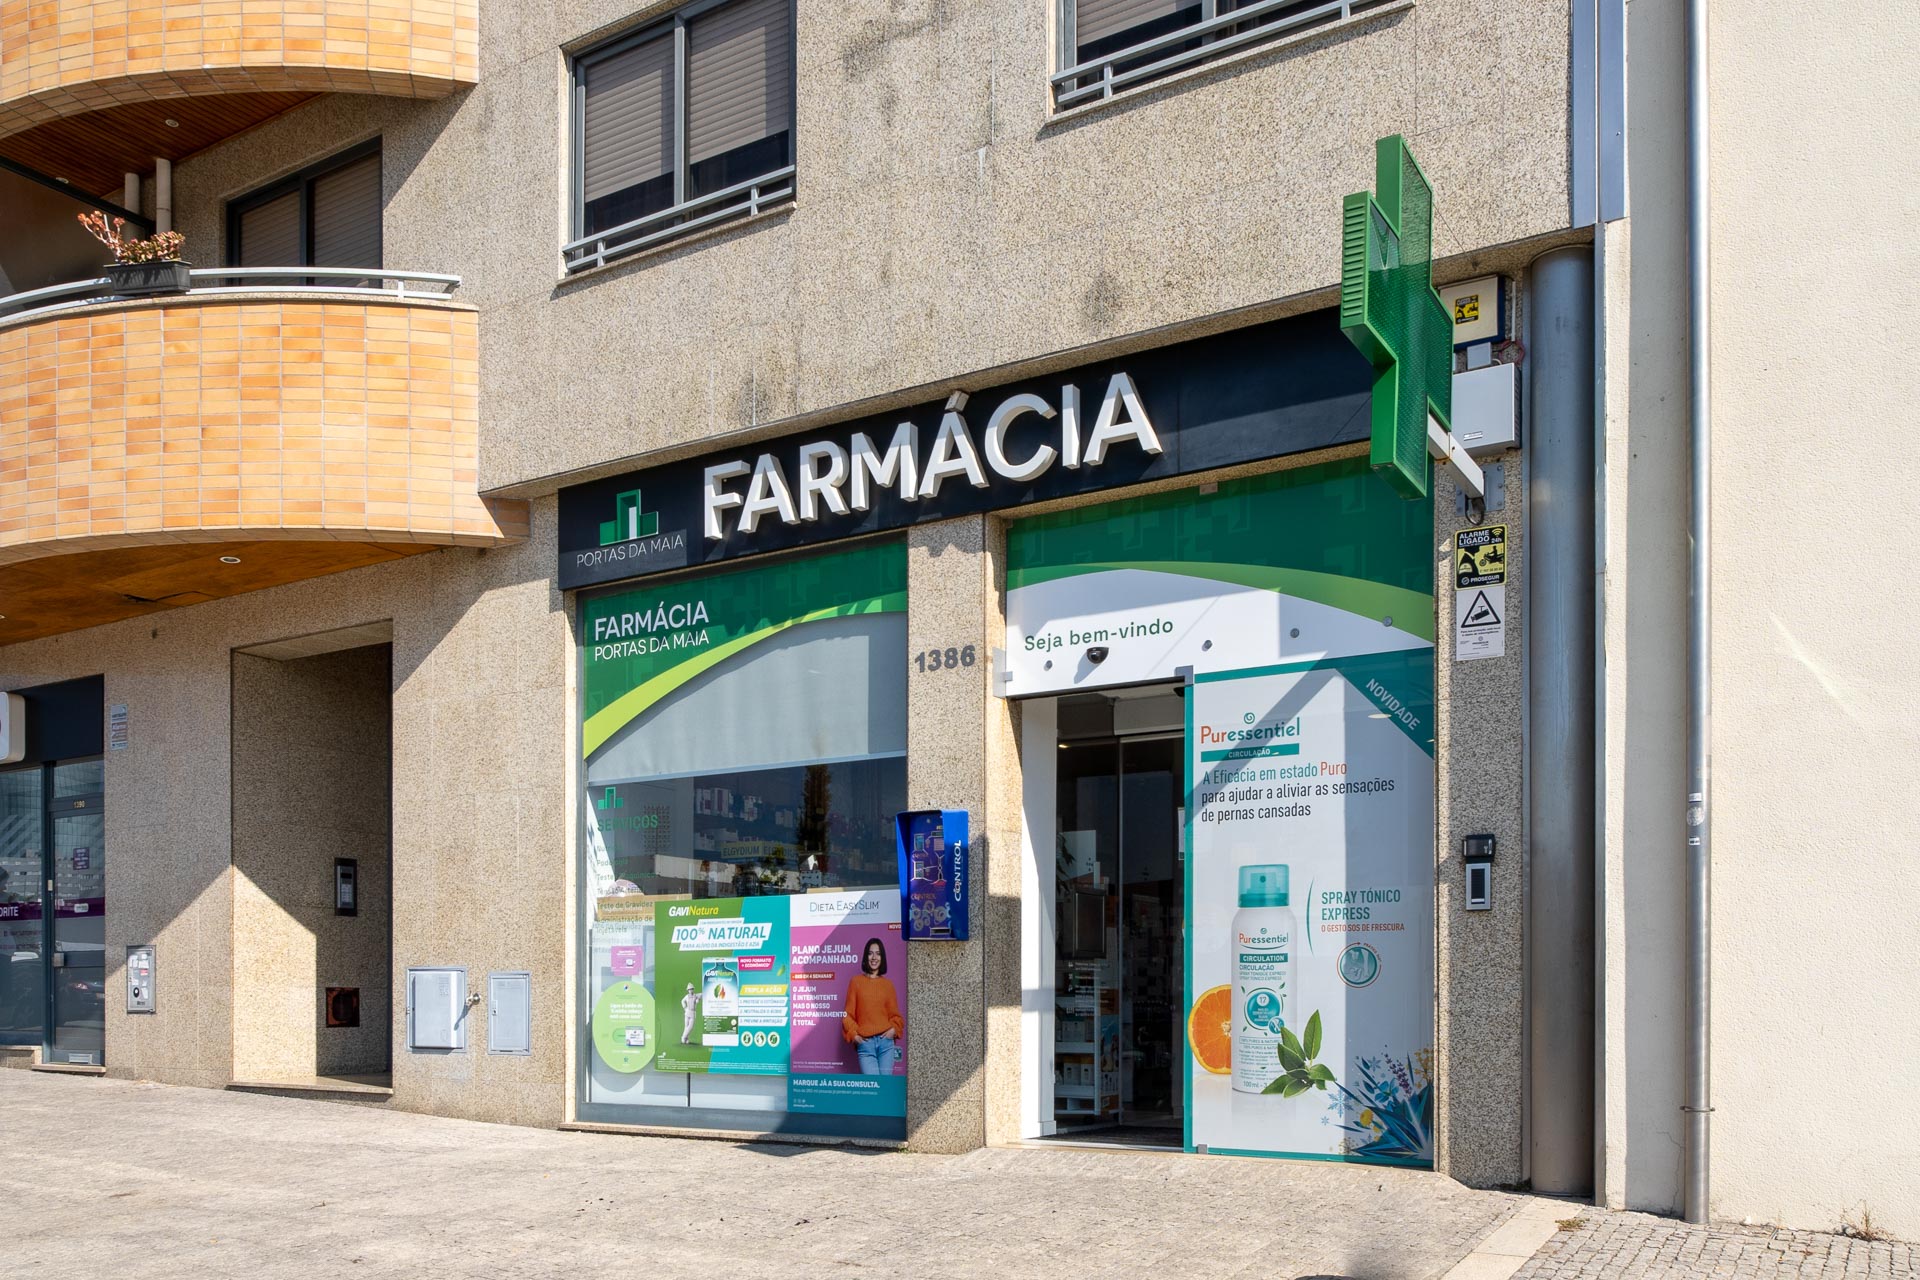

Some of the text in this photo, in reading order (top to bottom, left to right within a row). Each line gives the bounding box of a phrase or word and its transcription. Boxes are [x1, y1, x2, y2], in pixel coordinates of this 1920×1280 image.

[704, 371, 1164, 540] FARMÁCIA
[1459, 535, 1490, 546] LIGADO
[1460, 530, 1490, 539] ALARME
[576, 535, 684, 568] PORTAS DA MAIA
[1470, 575, 1500, 583] PROSEGUR
[594, 600, 710, 642] FARMÁCIA
[1024, 618, 1174, 653] Seja bem-vindo
[594, 629, 710, 661] PORTAS DA MAIA
[914, 644, 976, 674] 1386
[1365, 678, 1421, 731] NOVIDADE
[1200, 716, 1300, 744] Puressentiel
[1228, 748, 1271, 759] CIRCULAÇÃO
[1202, 761, 1348, 785] A Eficácia em estado Puro
[1201, 777, 1395, 807] para ajudar a aliviar as sensações
[1201, 802, 1311, 824] de pernas cansadas
[597, 814, 659, 832] SERVIÇOS
[953, 840, 962, 901] CONTROL
[1321, 887, 1401, 905] SPRAY TÓNICO
[597, 902, 615, 910] Teste
[625, 901, 653, 909] Gravidez
[668, 905, 719, 917] GAVINatura
[809, 901, 835, 913] DIETA
[1321, 906, 1371, 921] EXPRESS
[675, 926, 767, 941] 100% NATURAL
[1321, 922, 1405, 933] O GESTO SOS DE FRESCURA
[1239, 931, 1289, 944] Puressentiel
[792, 944, 851, 955] PLANO JEJUM
[791, 955, 858, 965] ACOMPANHADO
[793, 1079, 819, 1087] MARQUE
[819, 1078, 828, 1087] JÁ
[833, 1080, 846, 1088] SUA
[846, 1081, 880, 1089] CONSULTA.
